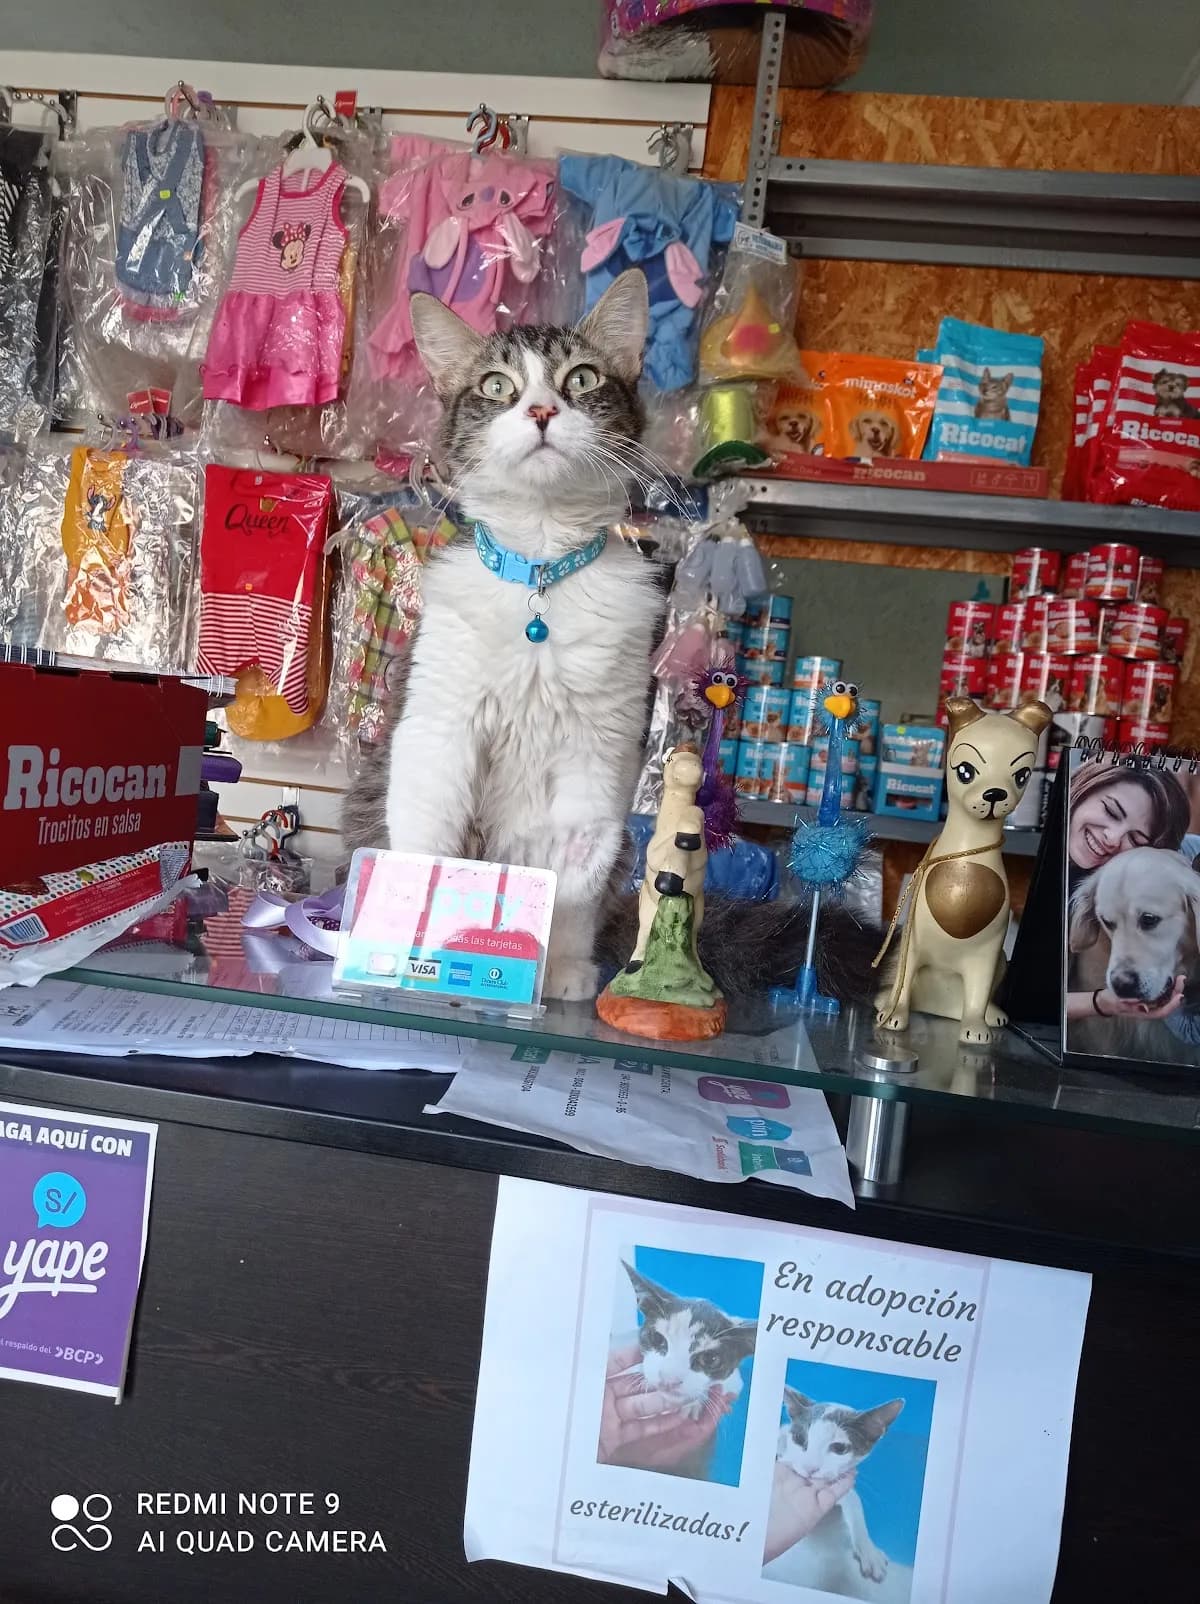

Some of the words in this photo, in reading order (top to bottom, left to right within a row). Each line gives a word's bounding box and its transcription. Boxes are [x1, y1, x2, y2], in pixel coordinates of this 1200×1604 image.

[940, 421, 1027, 453] Ricocat
[1120, 419, 1200, 448] Ricoca
[224, 503, 289, 537] Queen
[3, 744, 167, 810] Ricocan
[38, 813, 91, 845] Trocitos
[94, 815, 110, 838] en
[112, 808, 142, 835] salsa
[486, 936, 523, 951] tarjetas
[411, 962, 437, 977] VISA
[36, 1126, 88, 1151] AQUÍ
[90, 1134, 133, 1157] CON
[0, 1237, 110, 1320] yape
[773, 1260, 812, 1294] En
[825, 1273, 977, 1323] adopción
[5, 1339, 38, 1351] respaldo
[39, 1344, 52, 1354] del
[765, 1311, 963, 1363] responsable
[569, 1498, 750, 1543] esterilizadas!
